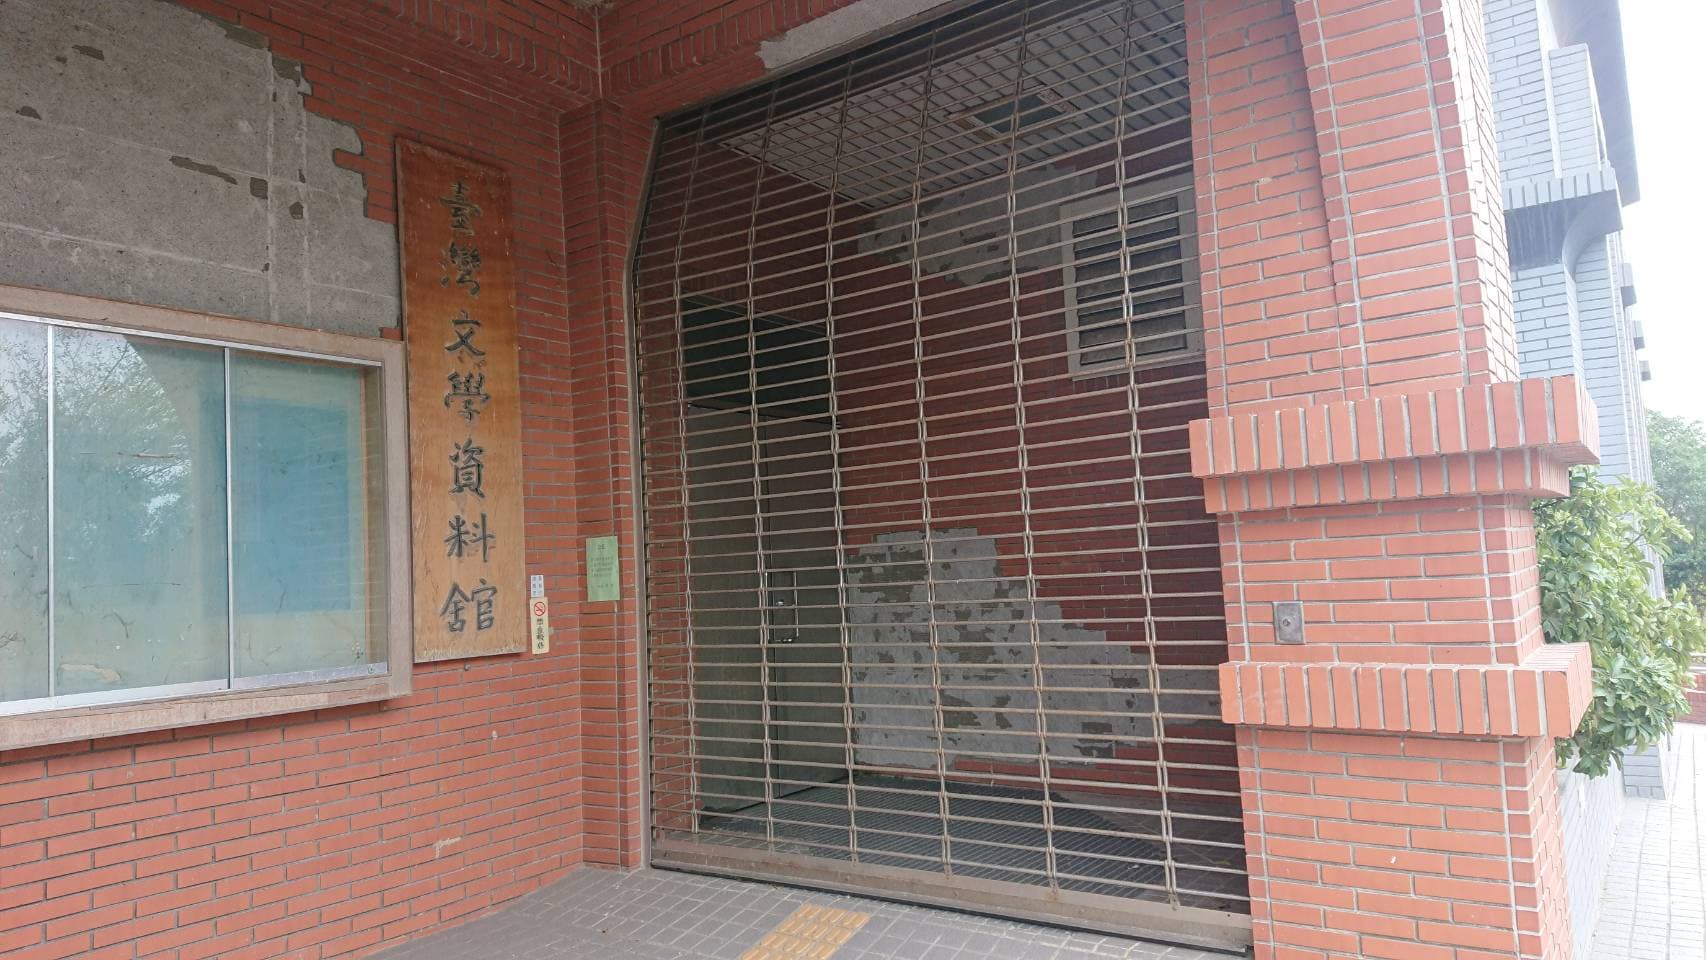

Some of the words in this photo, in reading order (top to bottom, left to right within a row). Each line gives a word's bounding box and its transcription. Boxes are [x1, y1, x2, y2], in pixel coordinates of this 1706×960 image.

[439, 181, 498, 633] 臺灣文學資料館
